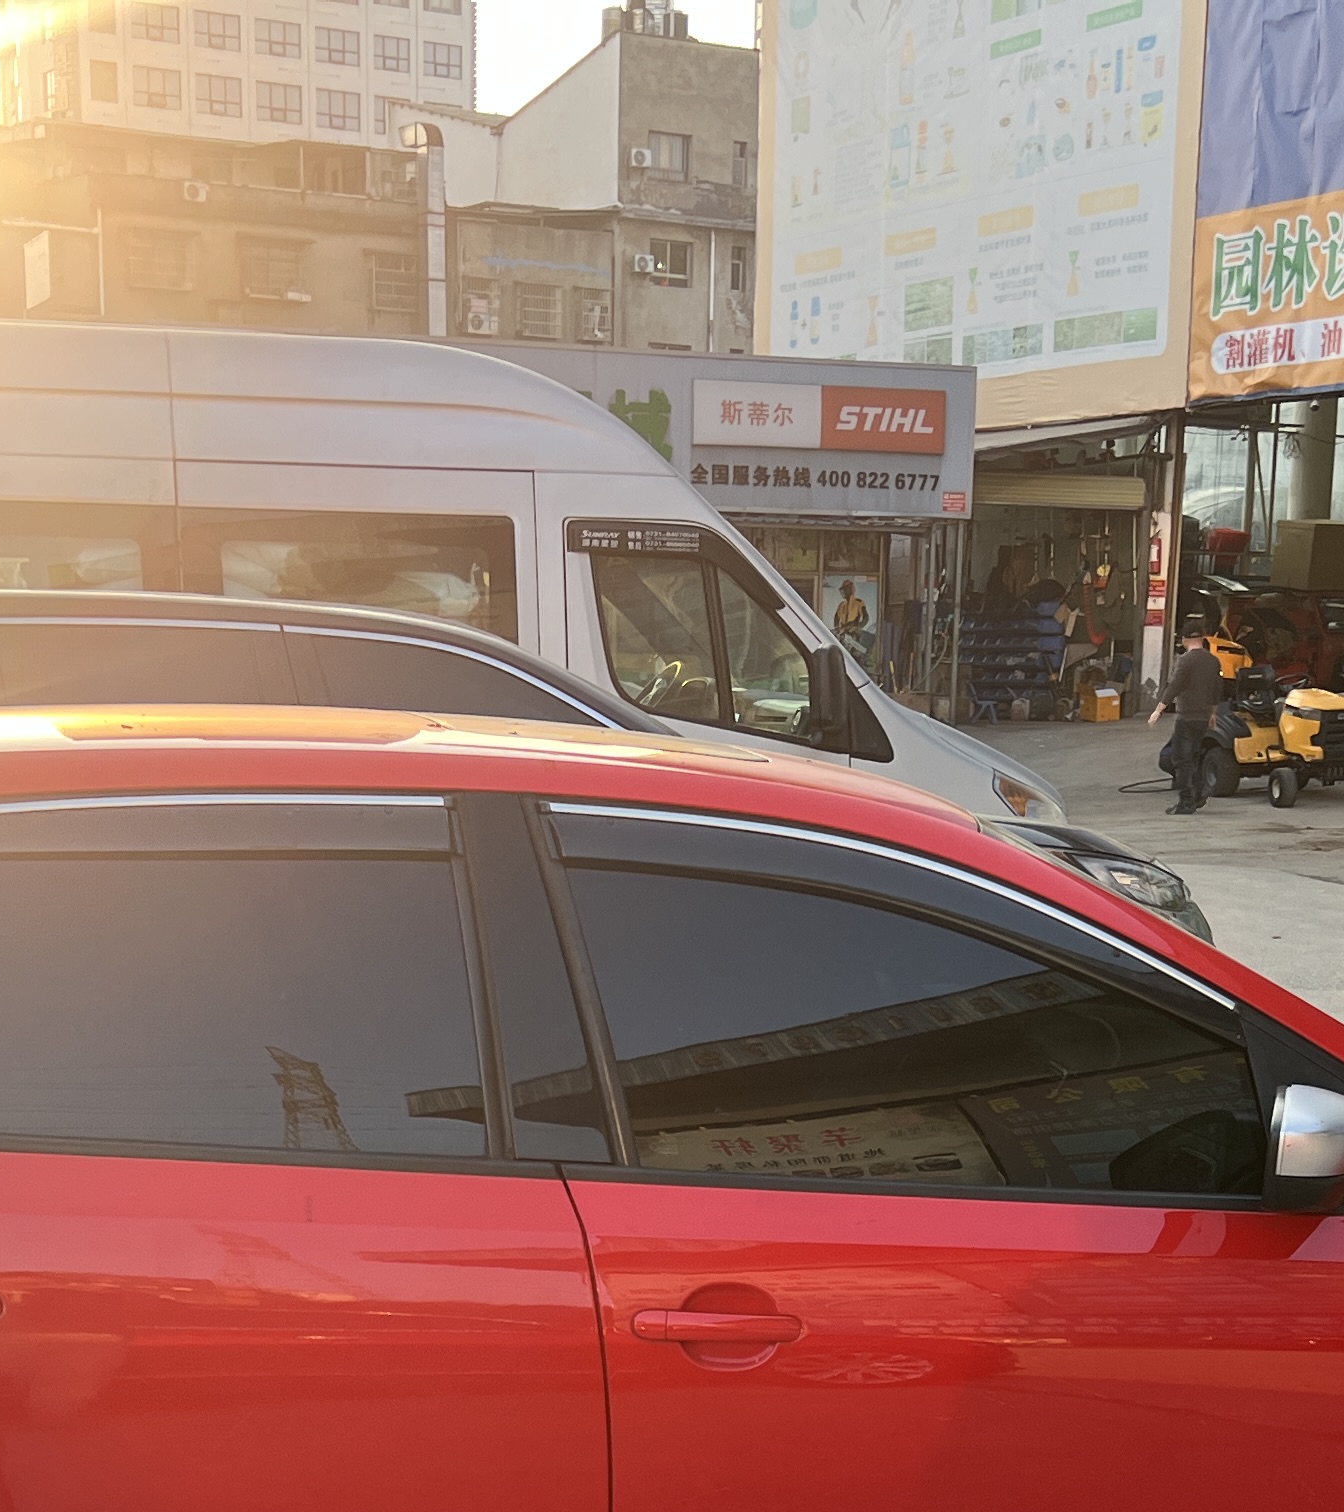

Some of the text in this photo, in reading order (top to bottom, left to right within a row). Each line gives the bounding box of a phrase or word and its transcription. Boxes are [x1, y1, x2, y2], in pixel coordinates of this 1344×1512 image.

[720, 399, 935, 435] 斯蒂尔 STIHL
[690, 462, 940, 492] 全国服务热线 400 822 6777
